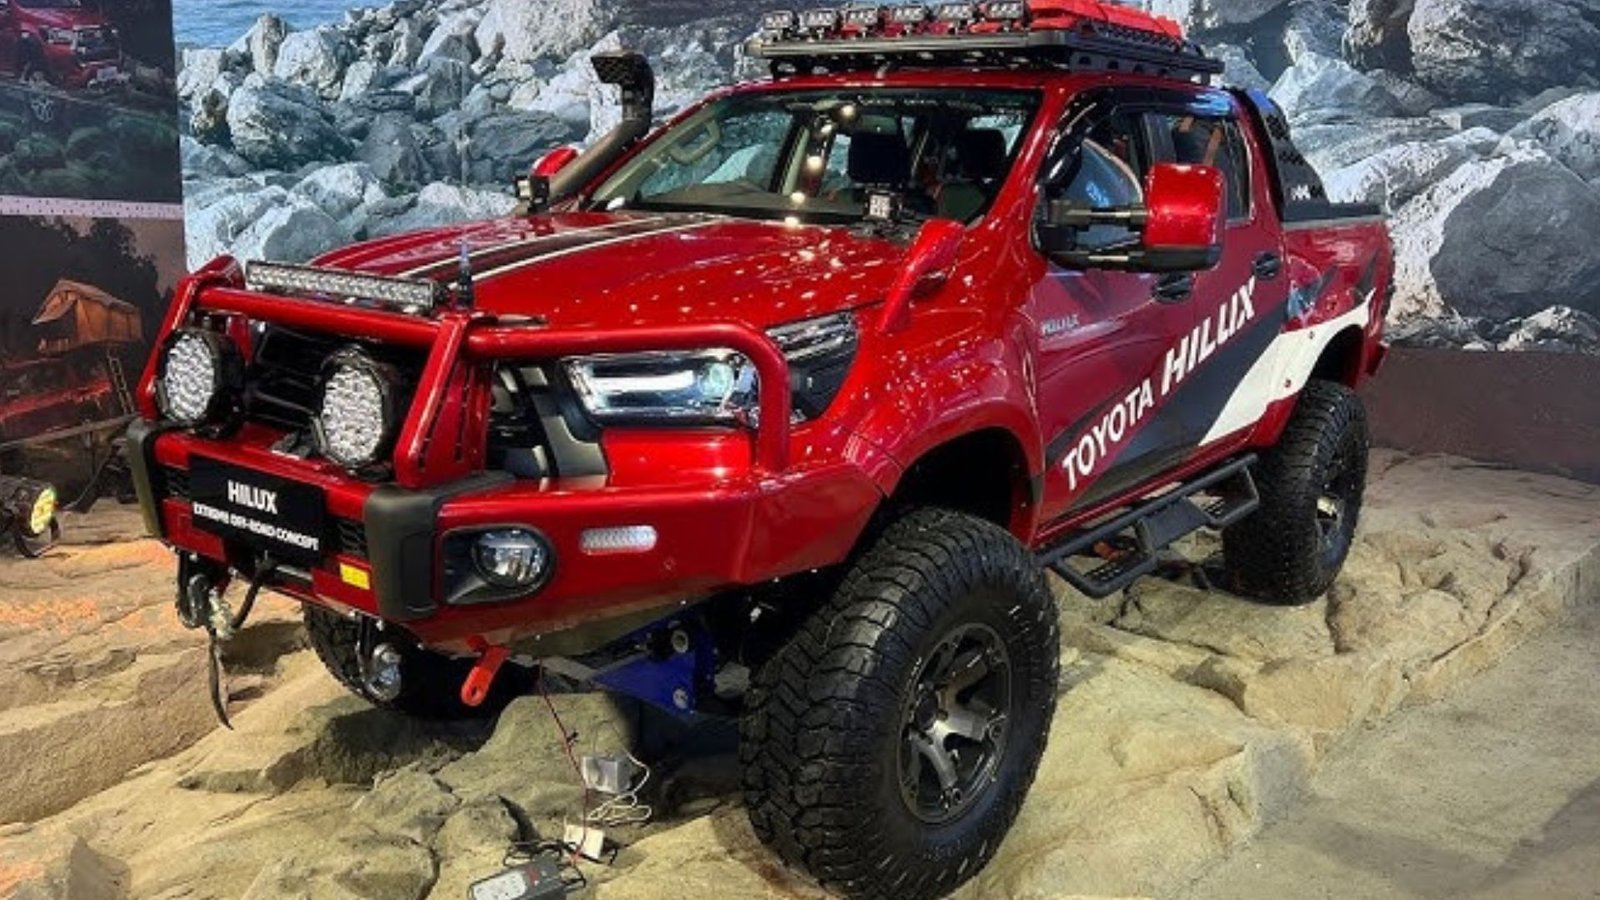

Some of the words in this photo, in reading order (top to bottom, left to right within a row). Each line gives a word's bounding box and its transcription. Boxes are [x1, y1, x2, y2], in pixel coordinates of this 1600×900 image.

[1062, 377, 1154, 491] TOYOTA
[1161, 275, 1255, 396] HILUX
[227, 479, 278, 515] HILUX
[276, 527, 320, 551] CONCEPT
